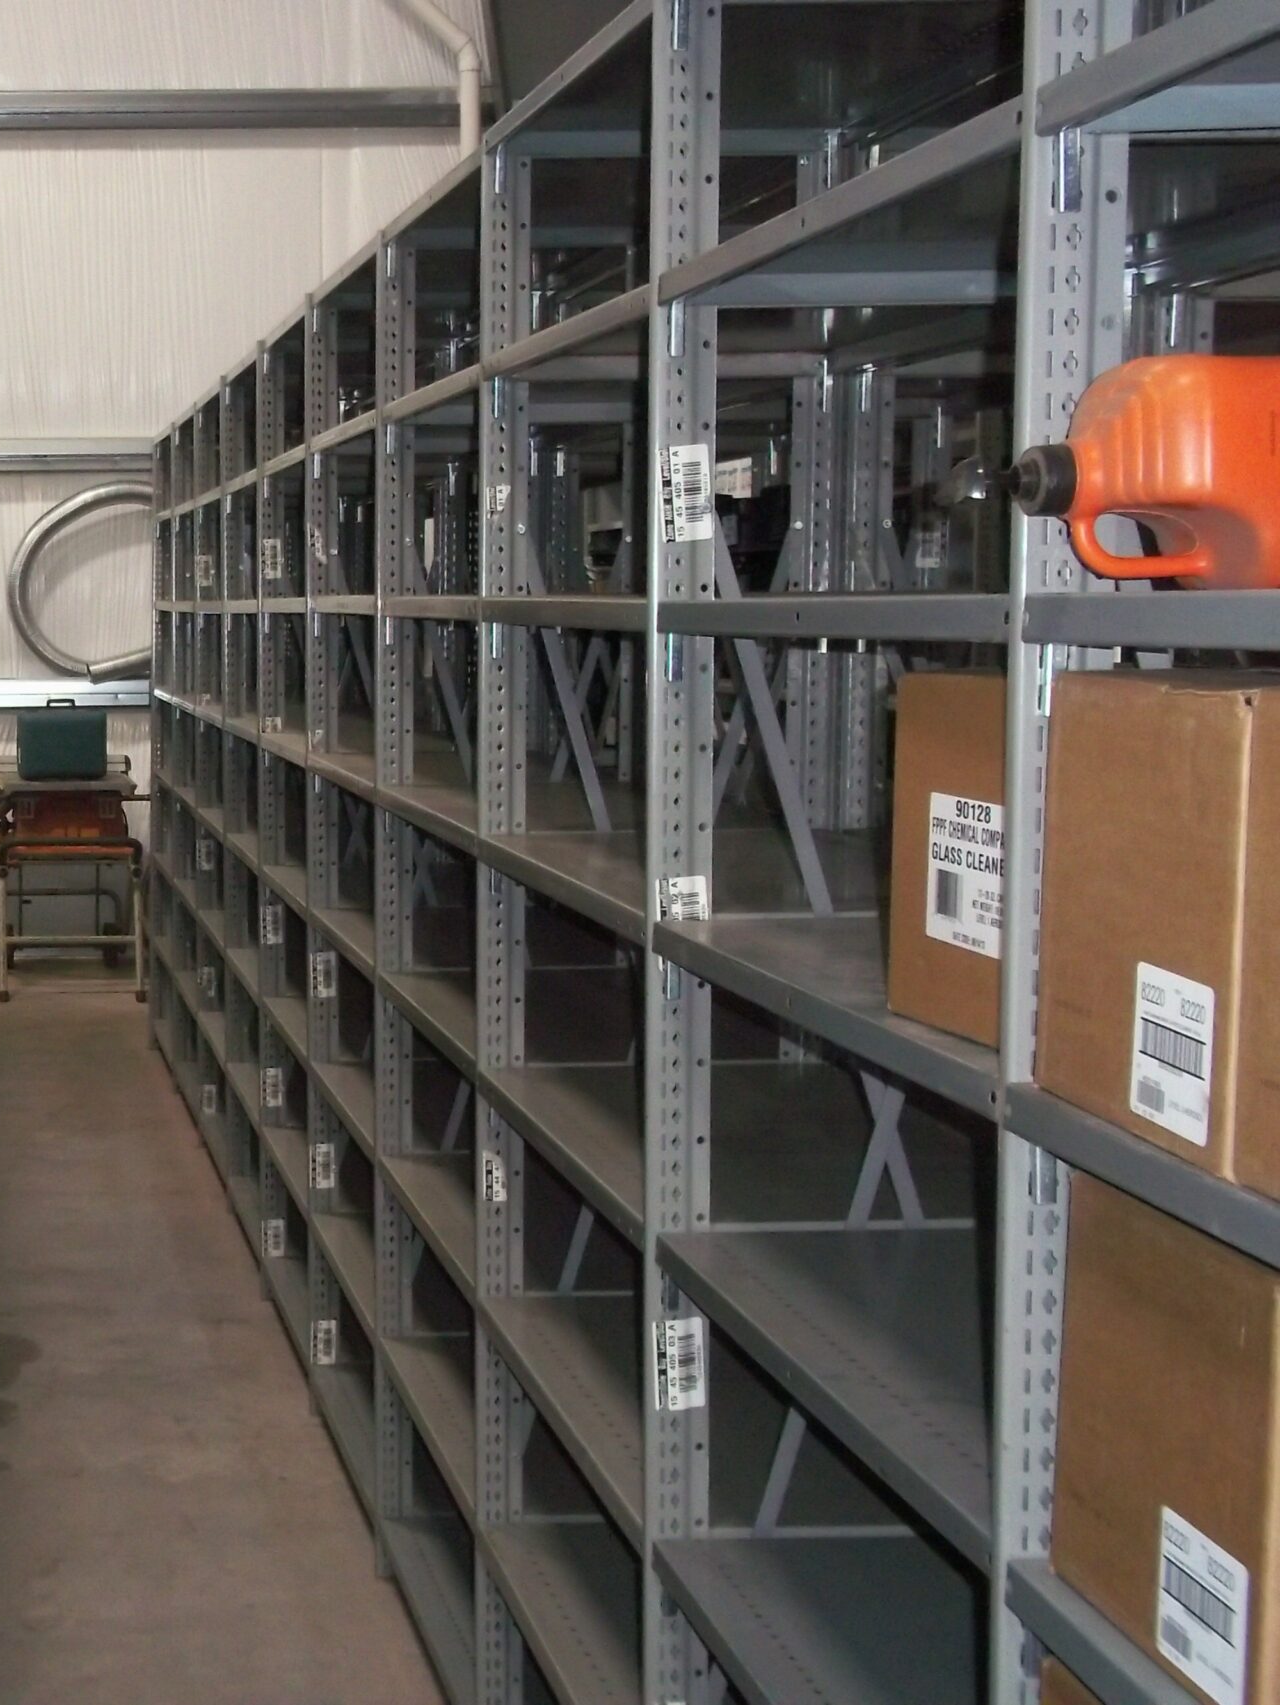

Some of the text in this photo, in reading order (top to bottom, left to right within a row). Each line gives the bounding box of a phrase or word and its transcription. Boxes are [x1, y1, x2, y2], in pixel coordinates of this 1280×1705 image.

[671, 450, 685, 537] 15 45 405 01 A
[955, 799, 992, 824] 90128
[932, 816, 948, 837] FPPF
[948, 820, 980, 845] CHEMICAL
[931, 841, 963, 866] GLASS
[670, 881, 679, 889] A
[667, 1324, 678, 1407] 15 45 405 03 A
